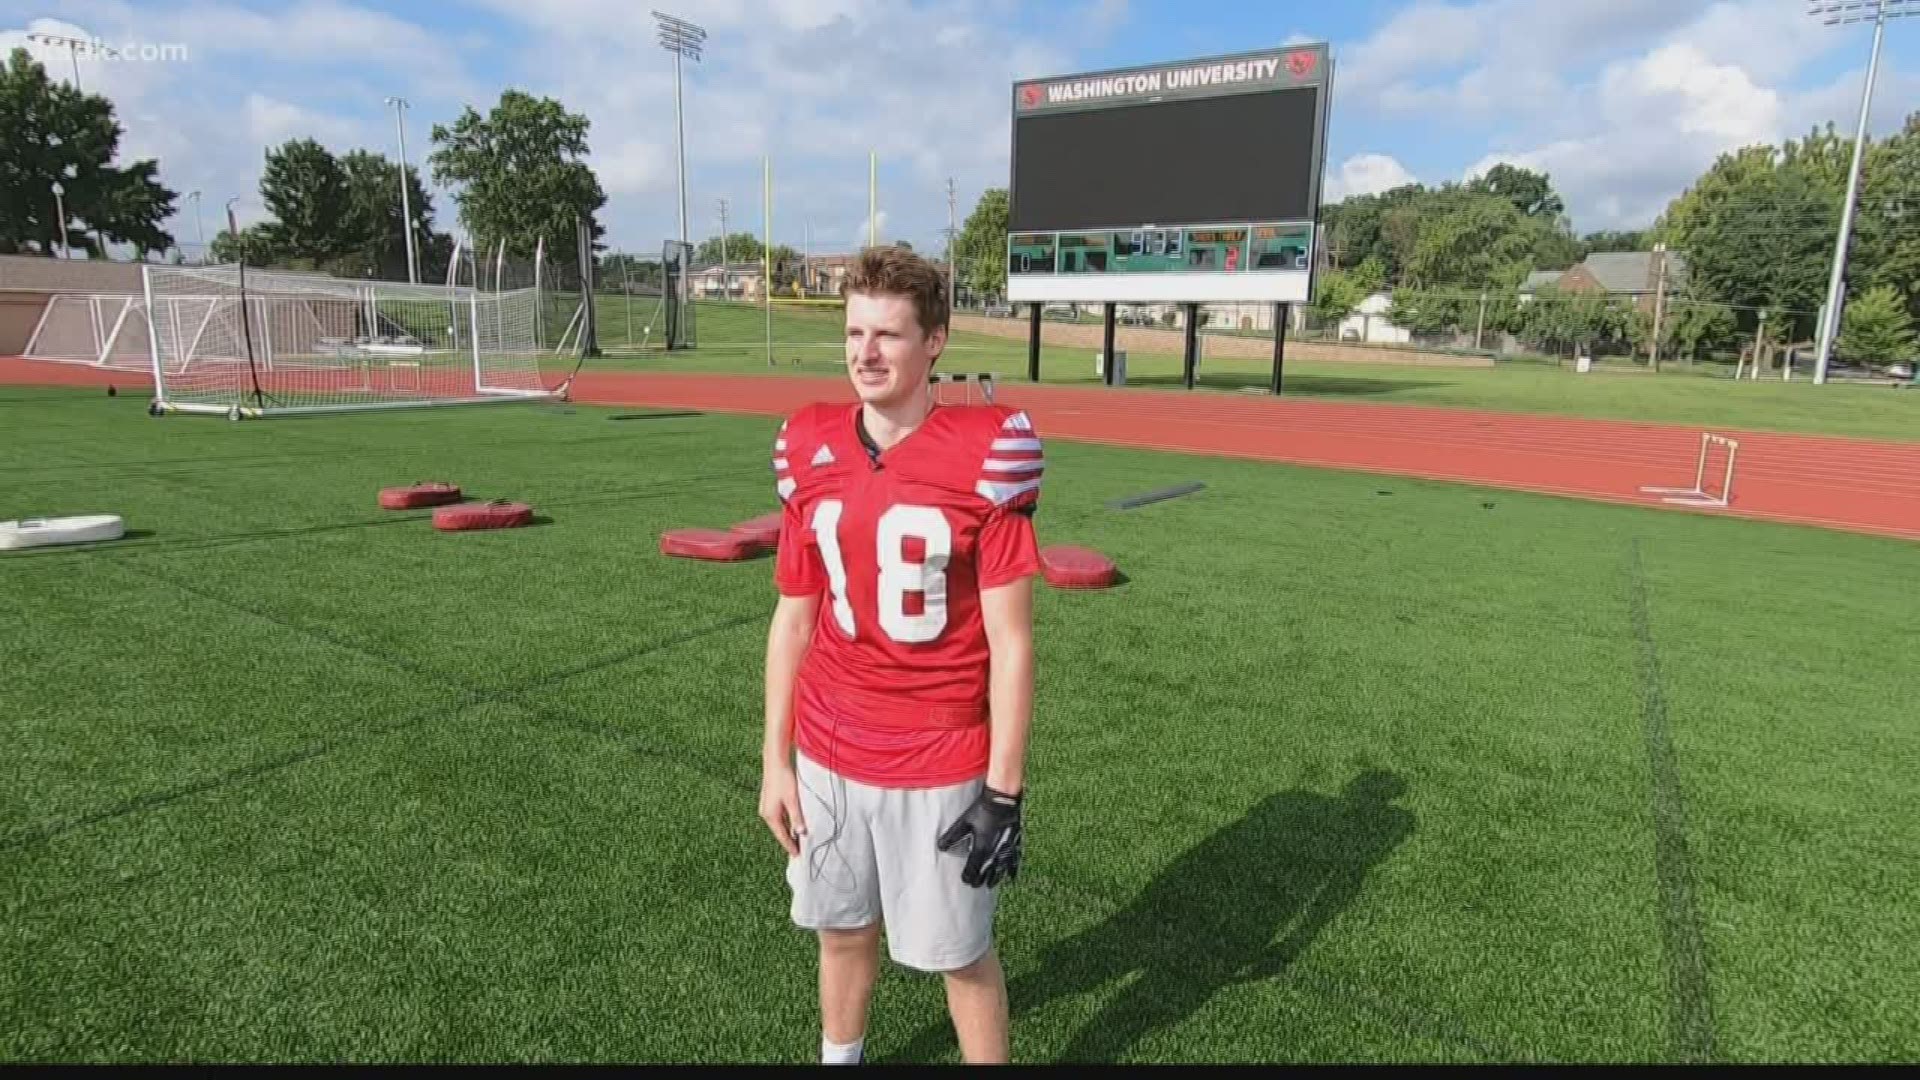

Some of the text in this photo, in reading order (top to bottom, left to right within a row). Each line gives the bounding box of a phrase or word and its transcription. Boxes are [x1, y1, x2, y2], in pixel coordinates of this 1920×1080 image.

[1049, 58, 1279, 102] WASHINGTON UNIVERSITY
[811, 498, 952, 642] 18
